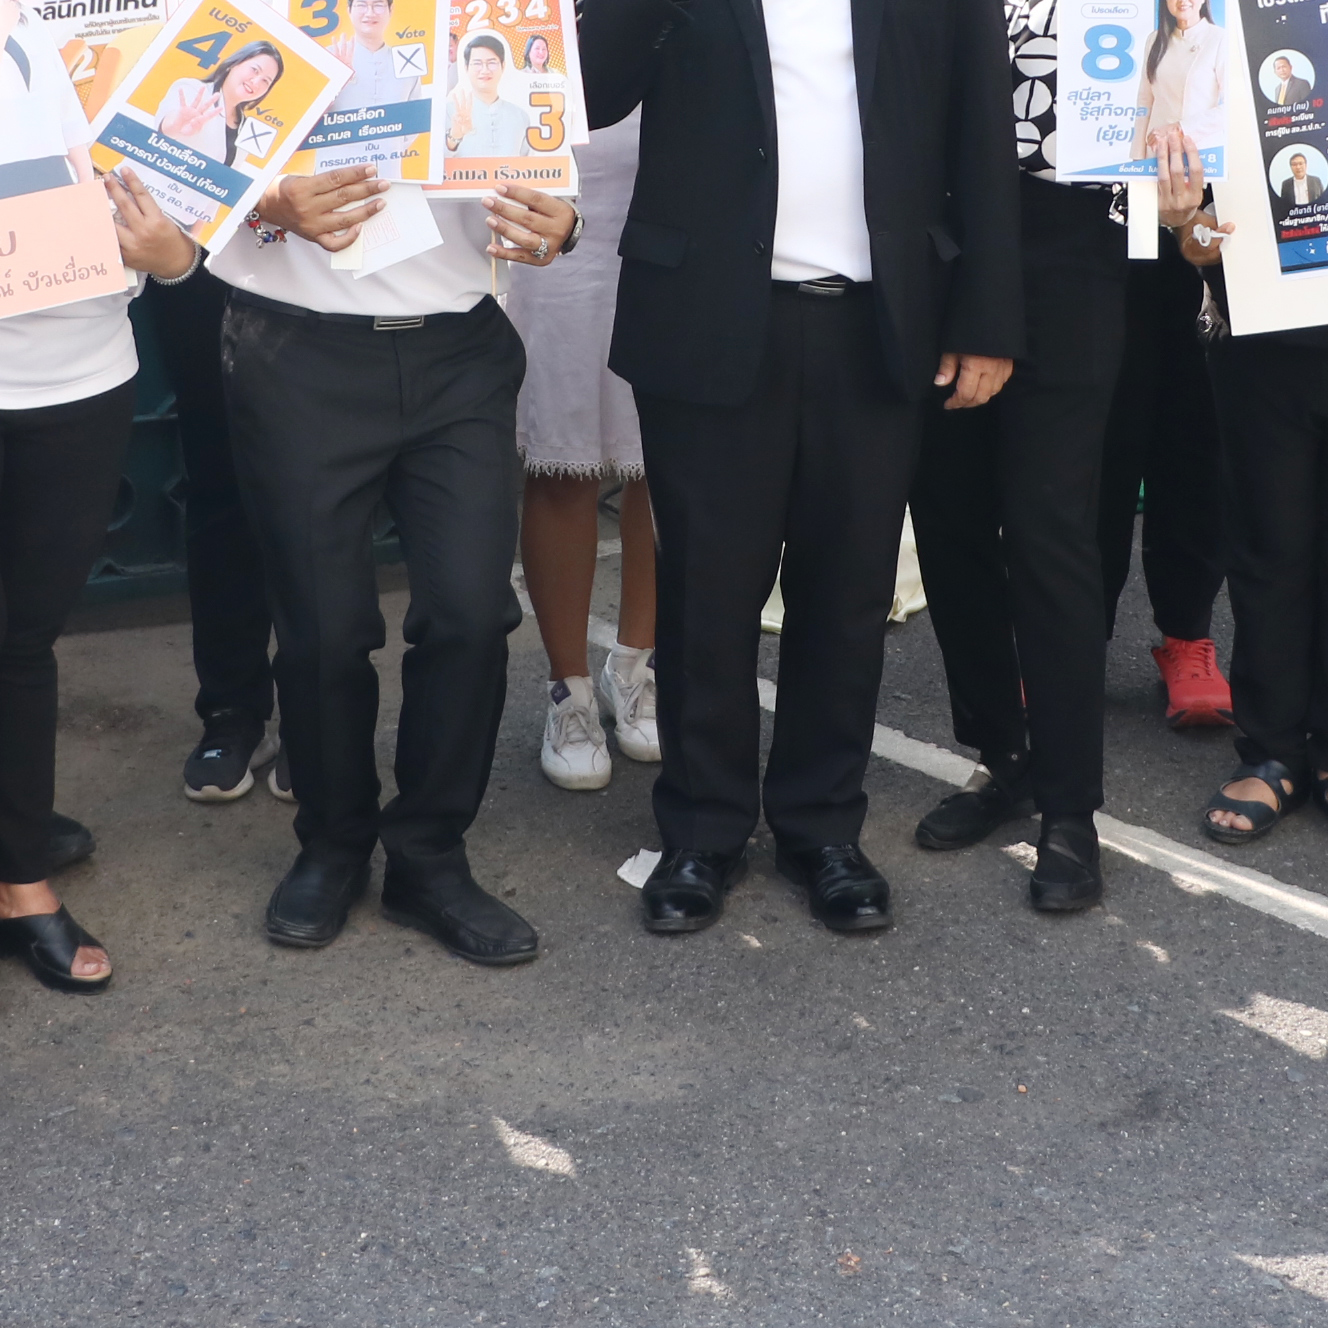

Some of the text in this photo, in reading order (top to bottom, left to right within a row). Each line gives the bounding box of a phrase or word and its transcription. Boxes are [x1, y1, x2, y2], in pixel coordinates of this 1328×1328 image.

[176, 29, 233, 70] 4
[1081, 23, 1137, 82] 8
[1067, 87, 1111, 103] สุนีลา
[323, 106, 385, 126] โปรดเลือก
[526, 91, 566, 152] 3
